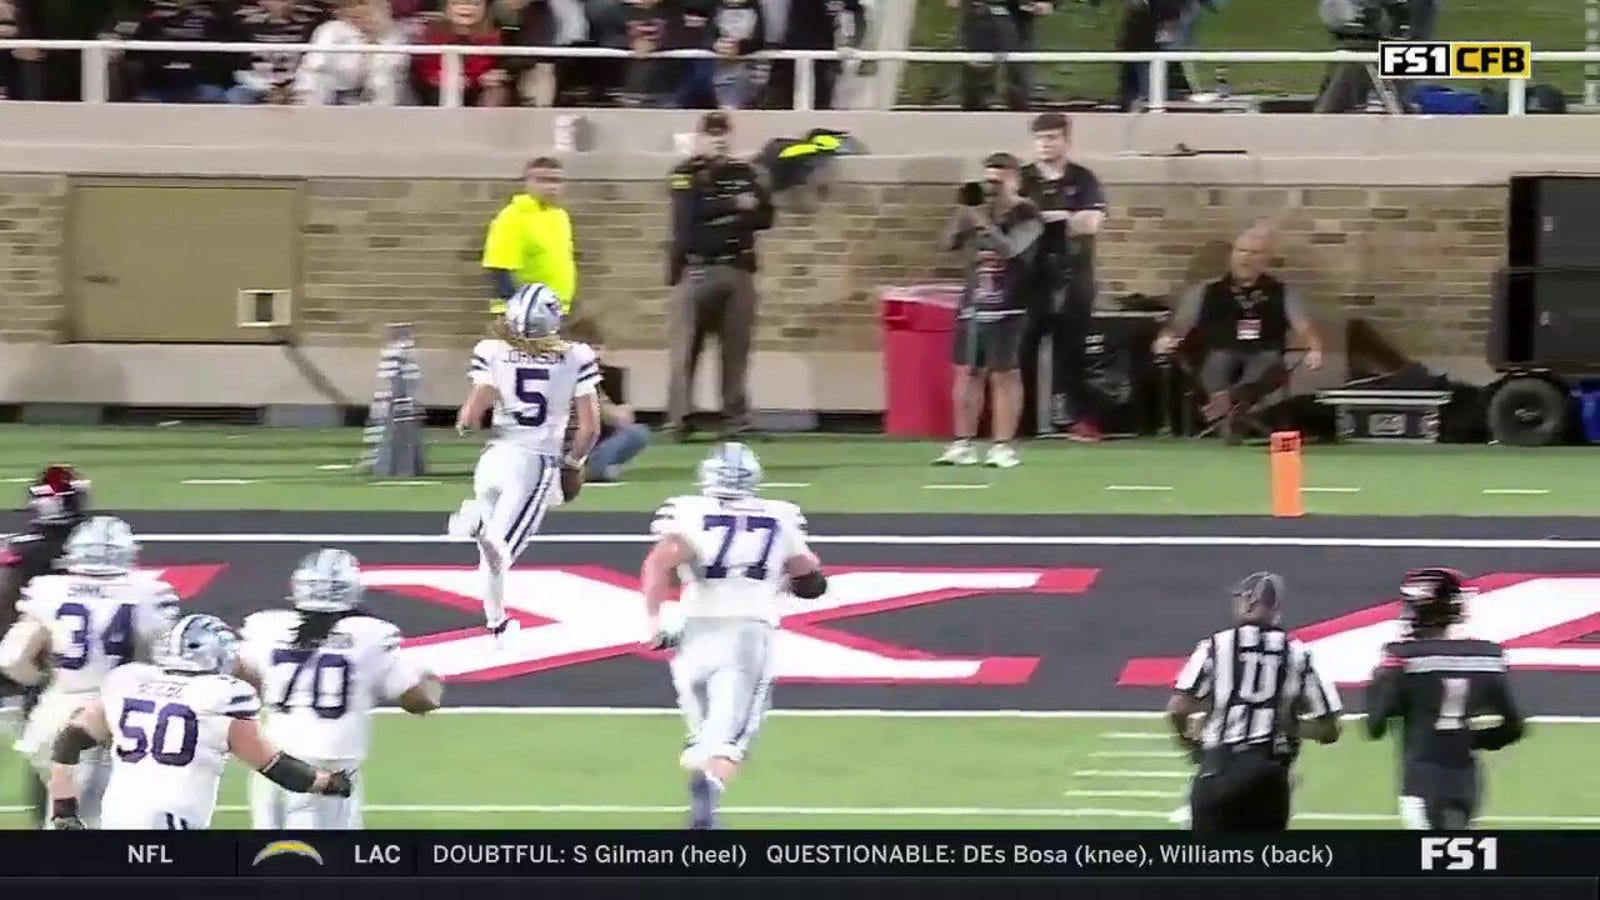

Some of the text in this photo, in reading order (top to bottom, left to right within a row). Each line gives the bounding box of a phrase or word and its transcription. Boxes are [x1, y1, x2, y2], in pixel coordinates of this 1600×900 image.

[512, 368, 550, 427] 5
[702, 514, 778, 581] 77
[54, 601, 136, 671] 34
[271, 648, 349, 720] 70
[1238, 650, 1283, 703] U
[1433, 677, 1468, 730] 1
[116, 697, 199, 768] 50
